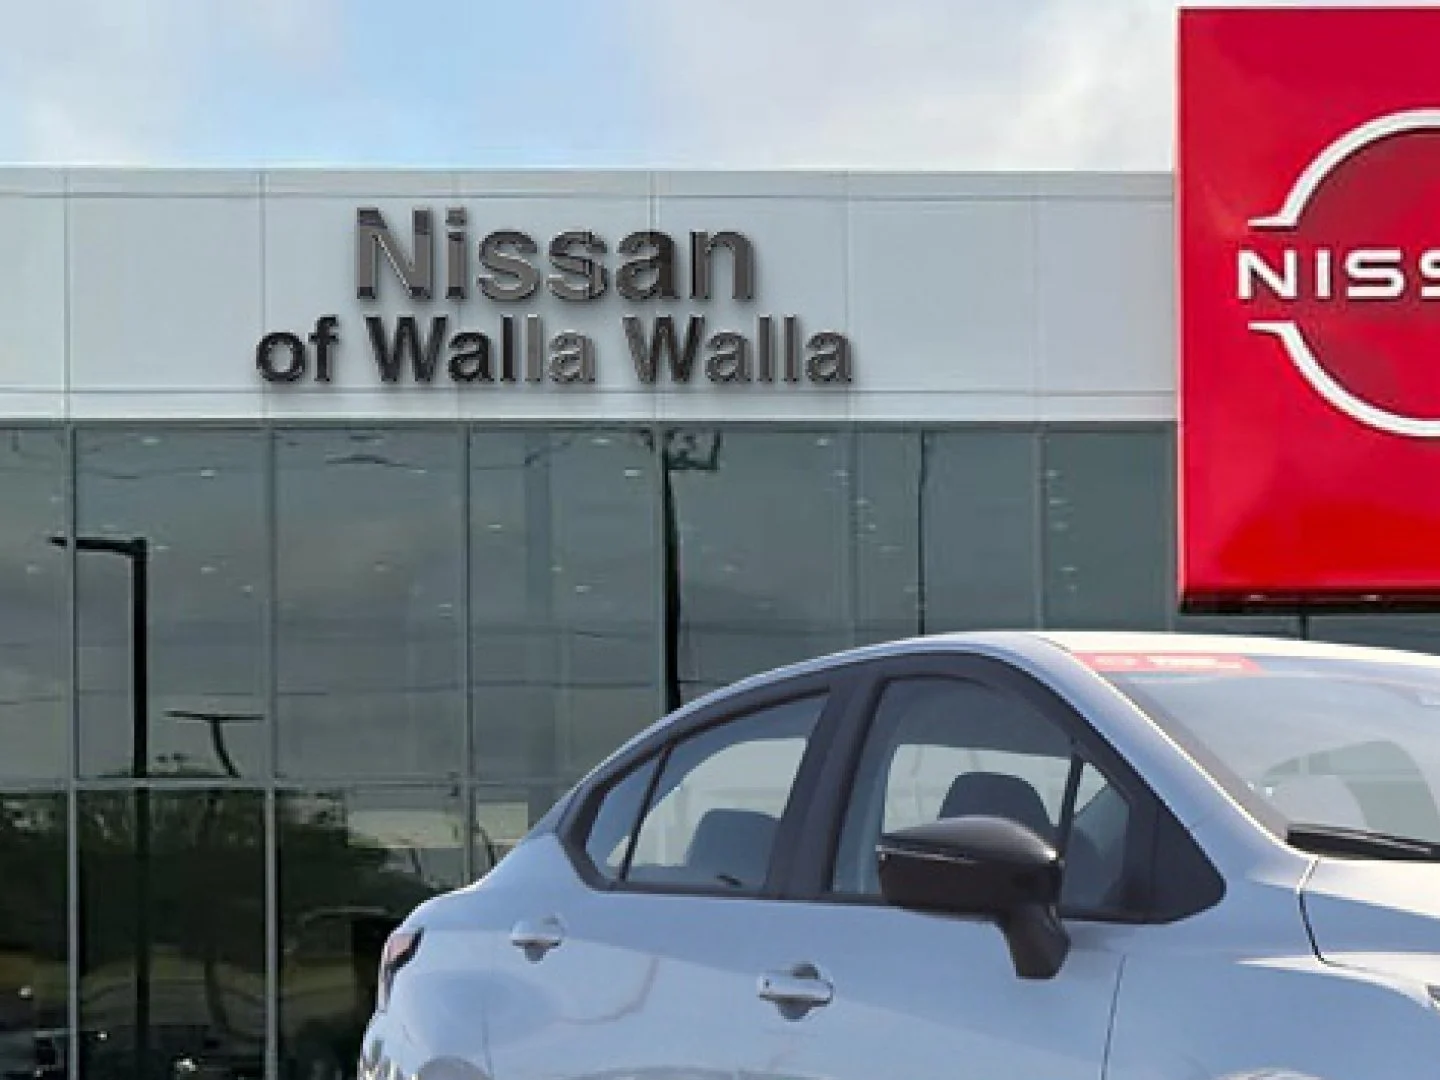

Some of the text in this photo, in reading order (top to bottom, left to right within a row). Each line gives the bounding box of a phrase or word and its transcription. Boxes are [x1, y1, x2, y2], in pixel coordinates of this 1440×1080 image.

[356, 206, 757, 301] Nissan
[256, 314, 853, 383] of Walla Walla
